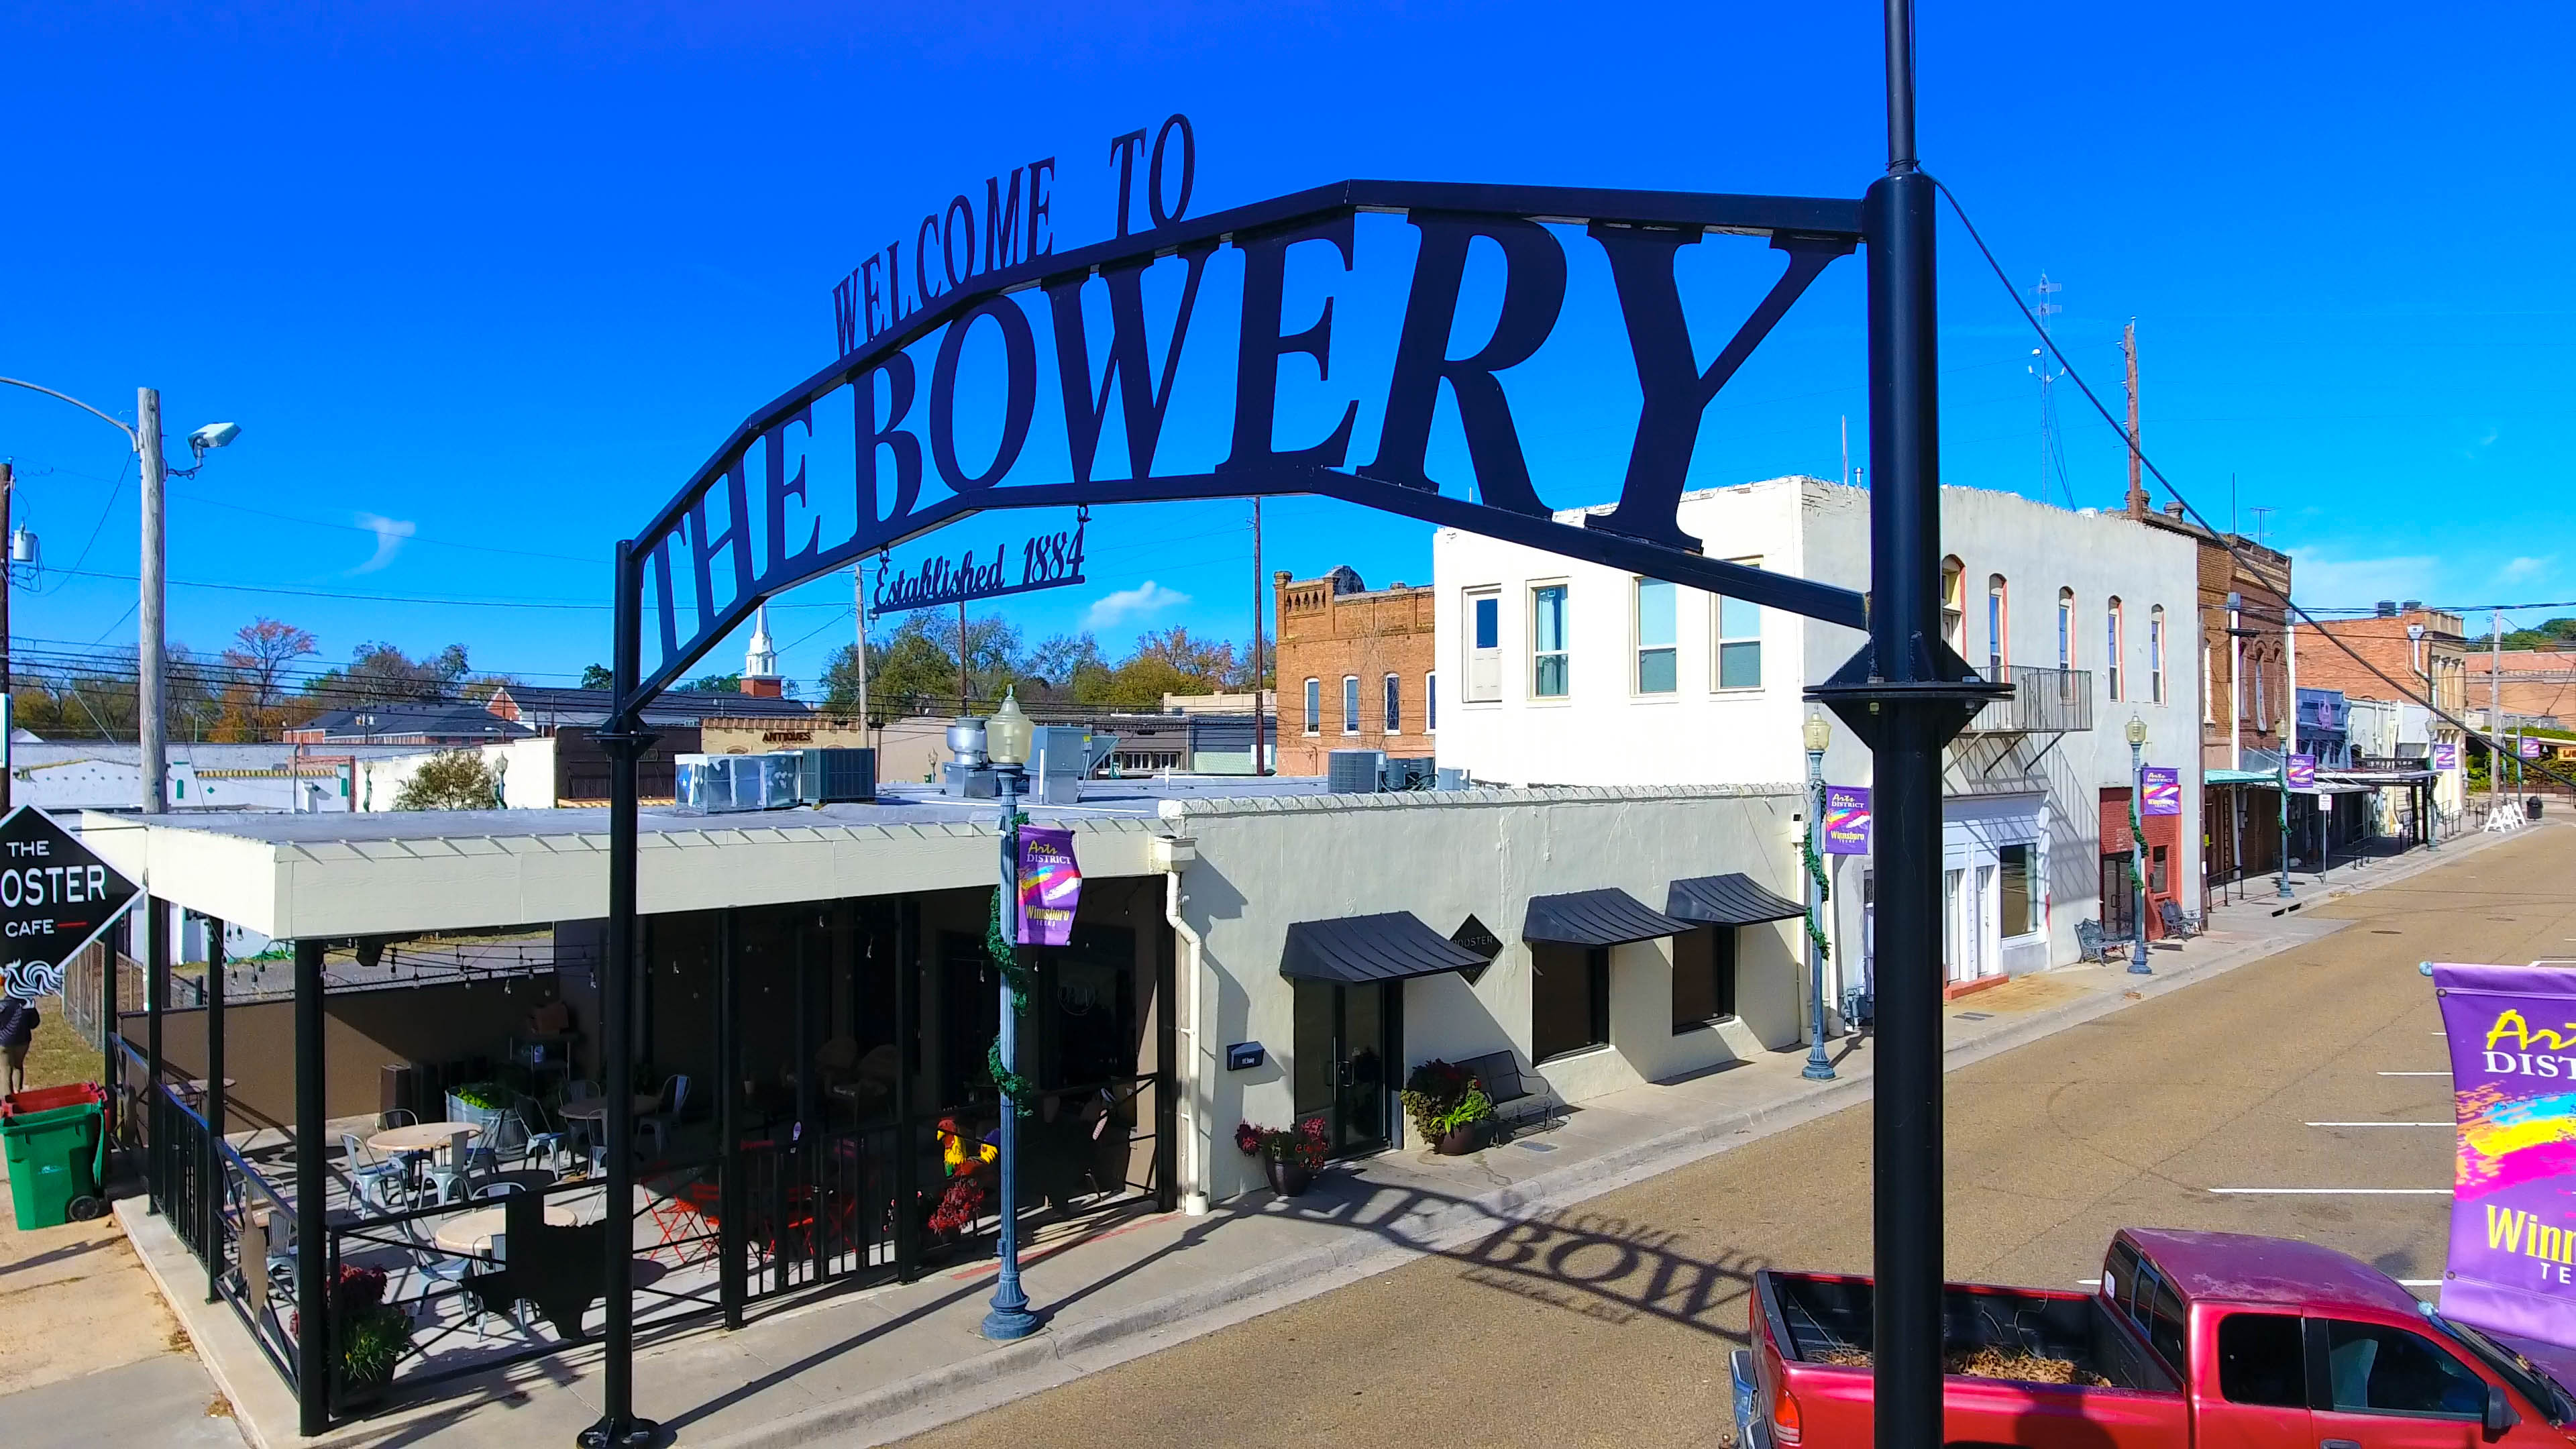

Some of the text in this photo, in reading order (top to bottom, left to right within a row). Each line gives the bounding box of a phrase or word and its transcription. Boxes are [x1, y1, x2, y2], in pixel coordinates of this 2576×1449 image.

[833, 113, 1195, 357] WELCOME TO
[641, 209, 1858, 671] THE BOWERY
[873, 526, 1085, 606] Established 1884
[762, 732, 812, 744] ANTIQUES
[1831, 794, 1855, 802] Arts
[6, 840, 50, 857] THE
[1028, 840, 1057, 854] Arts
[1026, 853, 1071, 865] DISTRICT
[1026, 905, 1070, 921] Winnsboro
[5, 919, 55, 937] CAFE
[2540, 1262, 2571, 1285] TE
